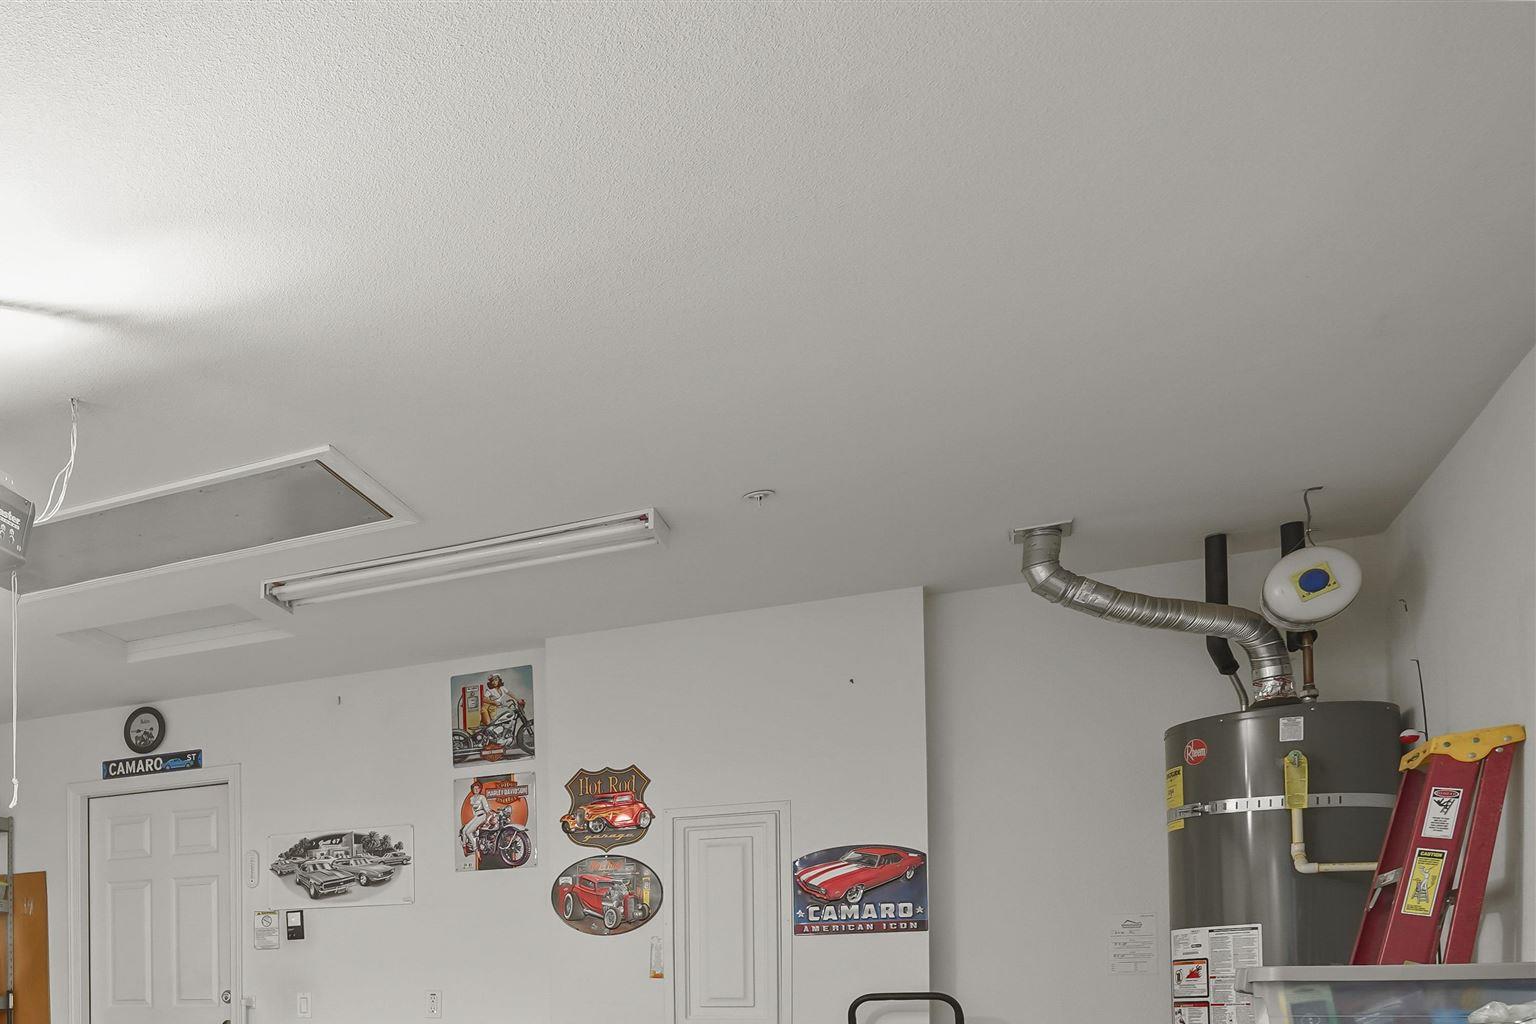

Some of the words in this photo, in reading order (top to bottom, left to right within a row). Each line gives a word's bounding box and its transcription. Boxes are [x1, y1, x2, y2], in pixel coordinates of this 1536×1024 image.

[1186, 740, 1207, 761] Rheem
[108, 757, 163, 776] CAMARO
[186, 753, 197, 761] ST
[579, 777, 602, 795] Hot
[609, 775, 636, 792] Rod
[808, 902, 914, 921] CAMARO
[803, 923, 874, 933] AMERICAN
[882, 922, 918, 930] ICON
